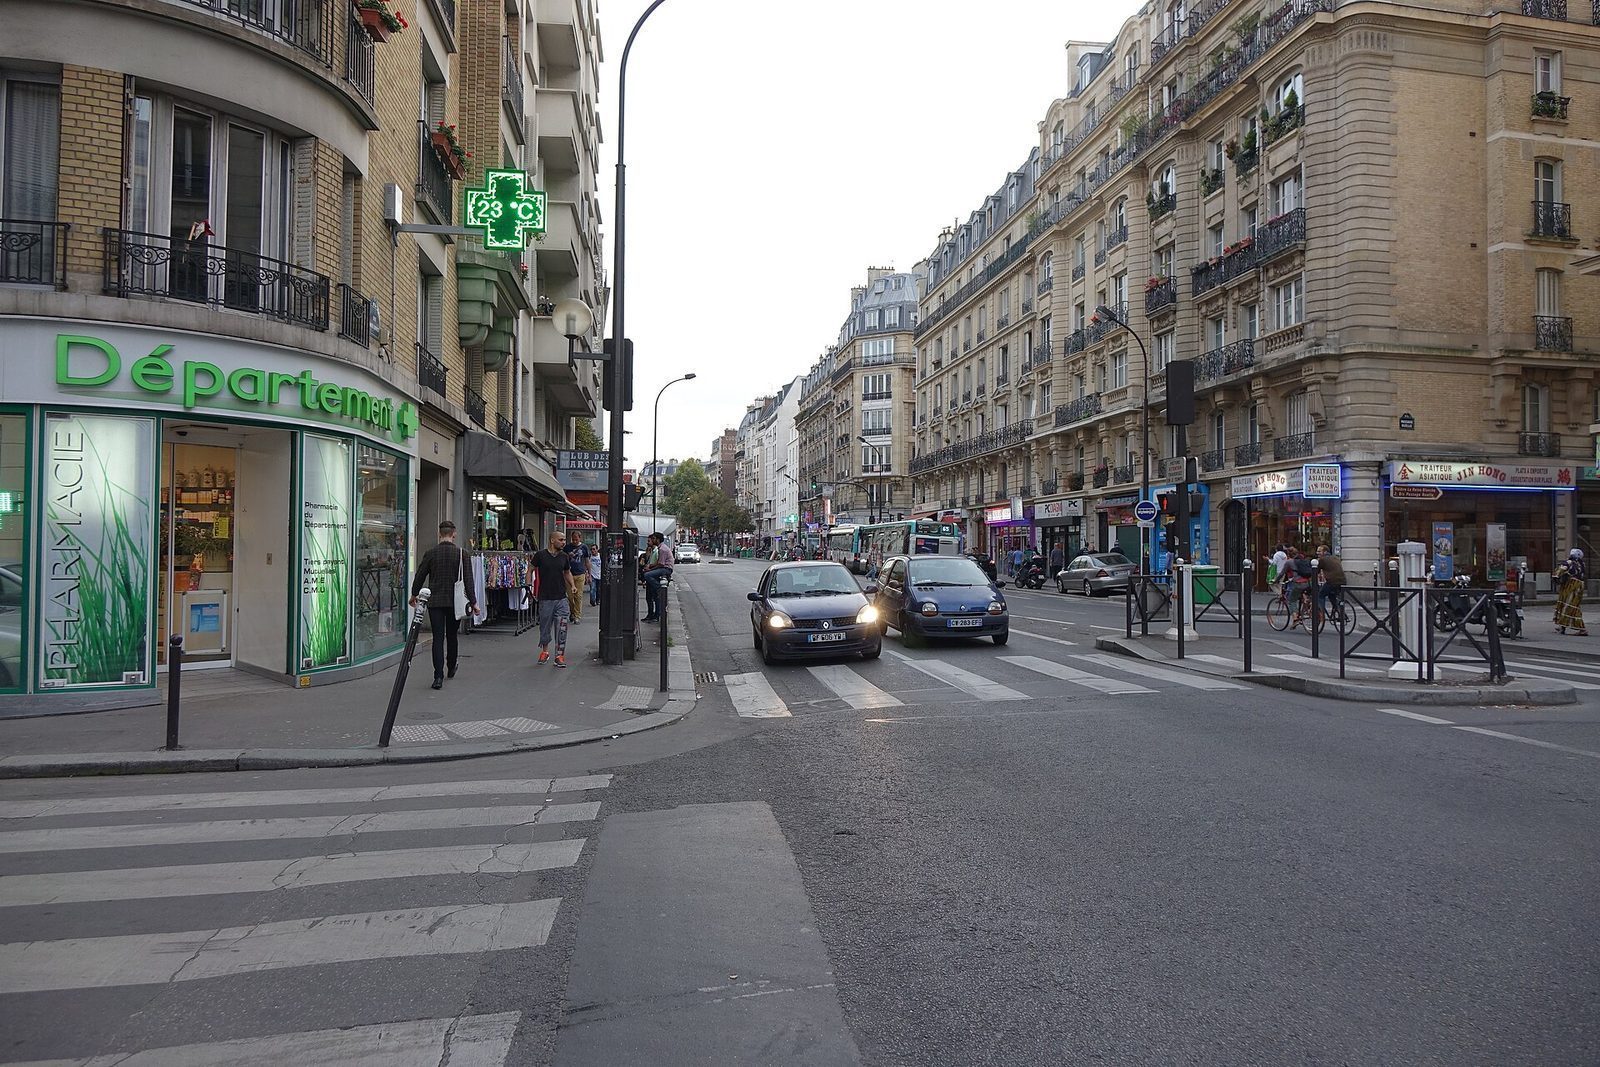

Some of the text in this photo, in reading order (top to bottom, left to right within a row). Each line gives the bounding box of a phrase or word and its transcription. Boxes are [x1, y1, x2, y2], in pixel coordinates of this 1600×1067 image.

[477, 200, 503, 218] 23
[55, 333, 393, 432] Département
[1397, 463, 1414, 480] 金
[1420, 464, 1452, 472] TRAITEUR
[1456, 465, 1506, 482] JIN HONG
[1254, 475, 1265, 488] JIN
[1267, 473, 1286, 485] HONG
[1419, 473, 1453, 481] ASIATIQUE
[1308, 483, 1319, 492] JIN
[1320, 482, 1338, 492] HONG
[304, 501, 338, 511] Pharmacie
[304, 520, 347, 529] Département
[46, 429, 85, 671] PHARMACIE
